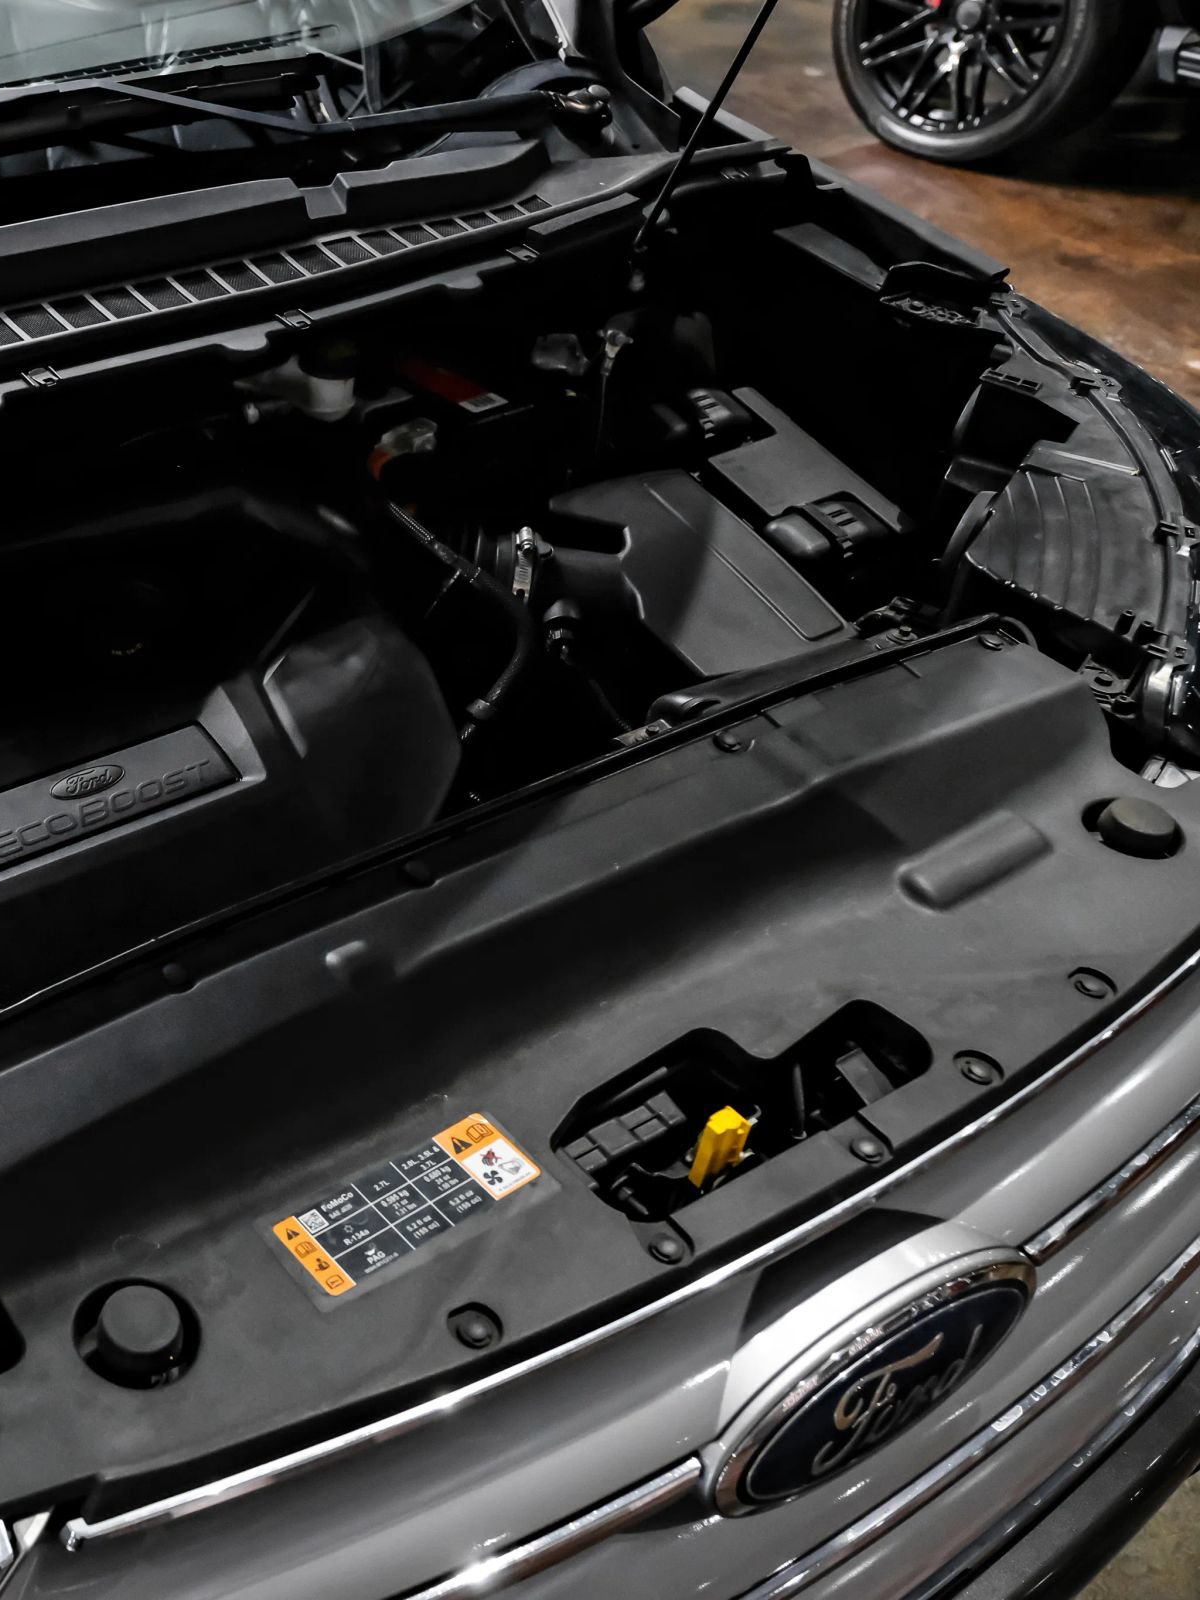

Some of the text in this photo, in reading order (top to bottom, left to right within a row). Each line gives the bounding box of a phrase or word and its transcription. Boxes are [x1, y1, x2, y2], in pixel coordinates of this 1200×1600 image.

[65, 767, 114, 794] Ford
[420, 1160, 436, 1171] 3.7L
[373, 1180, 391, 1192] 2.7L
[320, 1192, 354, 1213] FoMoCo
[343, 1228, 370, 1247] R-134a
[366, 1250, 387, 1265] PAG
[810, 1322, 984, 1477] Ford
